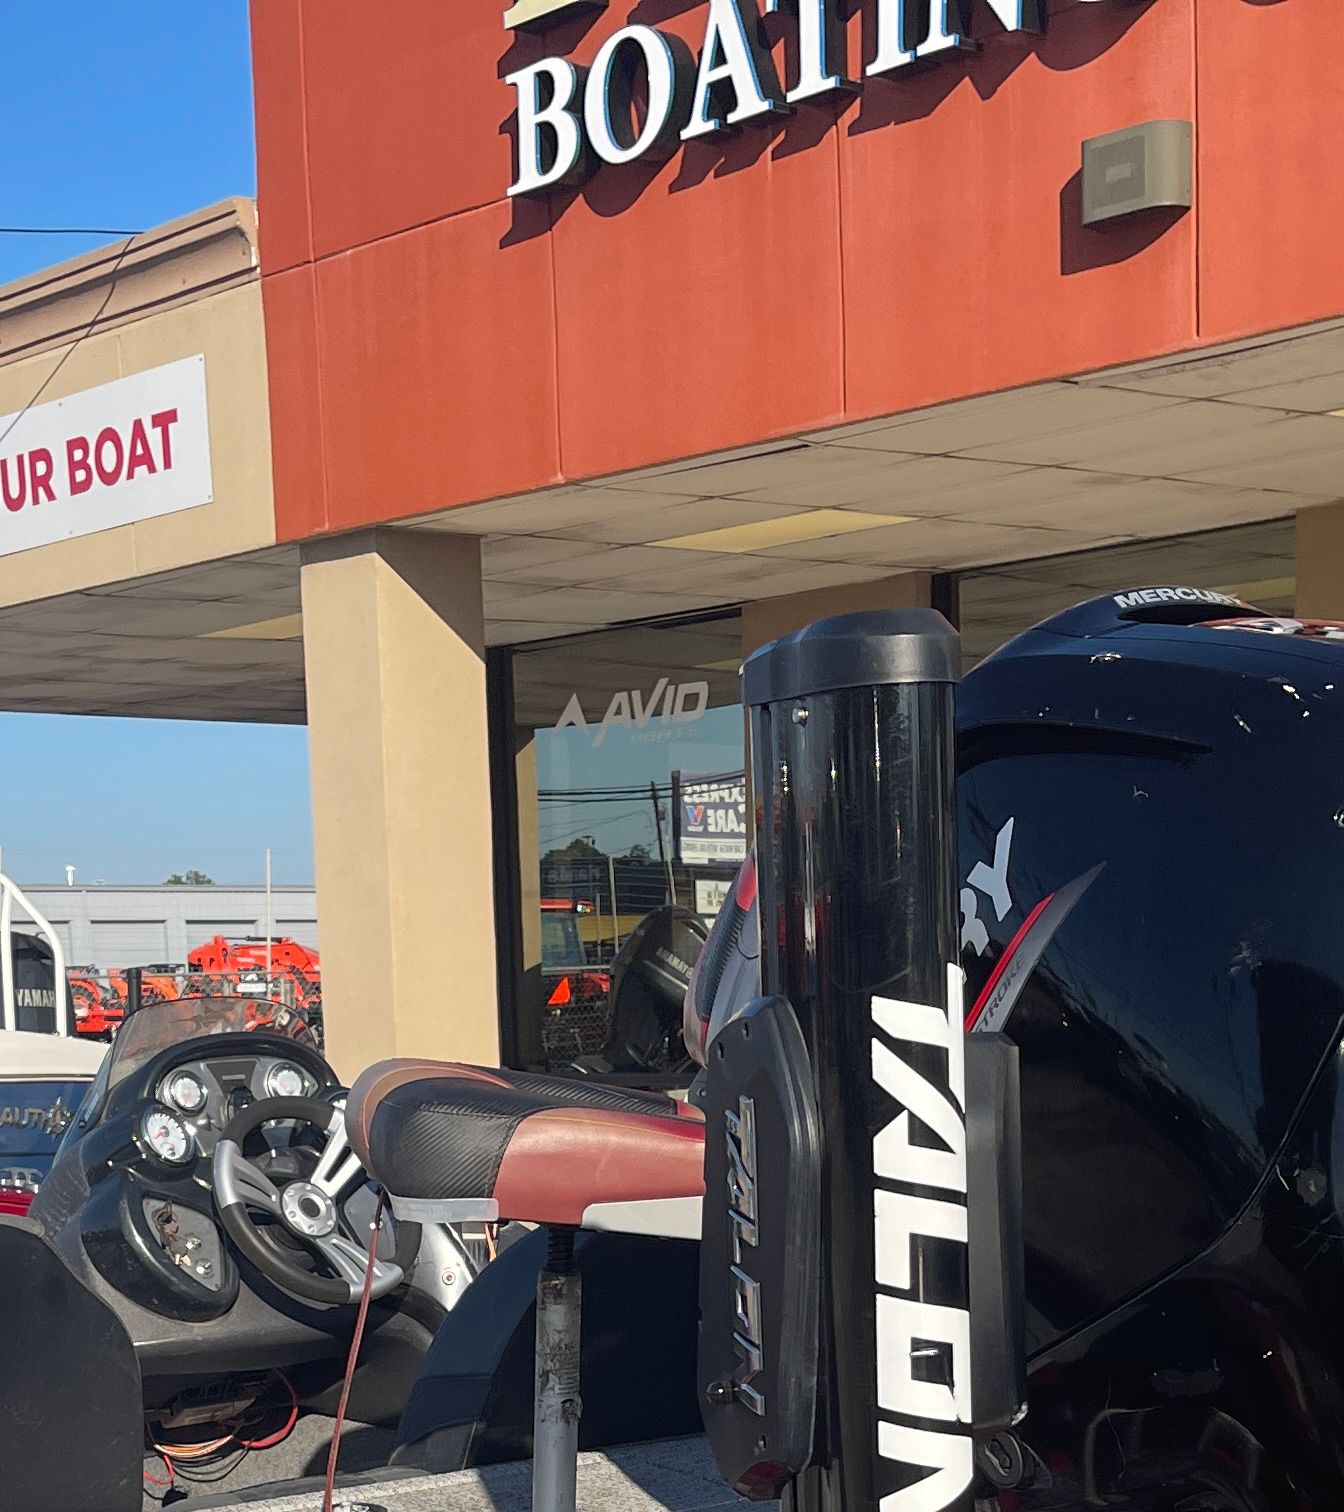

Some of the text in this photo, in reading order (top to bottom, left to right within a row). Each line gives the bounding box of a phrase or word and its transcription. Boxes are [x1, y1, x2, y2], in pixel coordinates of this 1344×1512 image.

[66, 407, 179, 496] BOAT
[592, 678, 709, 747] AVID
[15, 988, 56, 1008] YAMAH
[977, 952, 1024, 1032] TROKE
